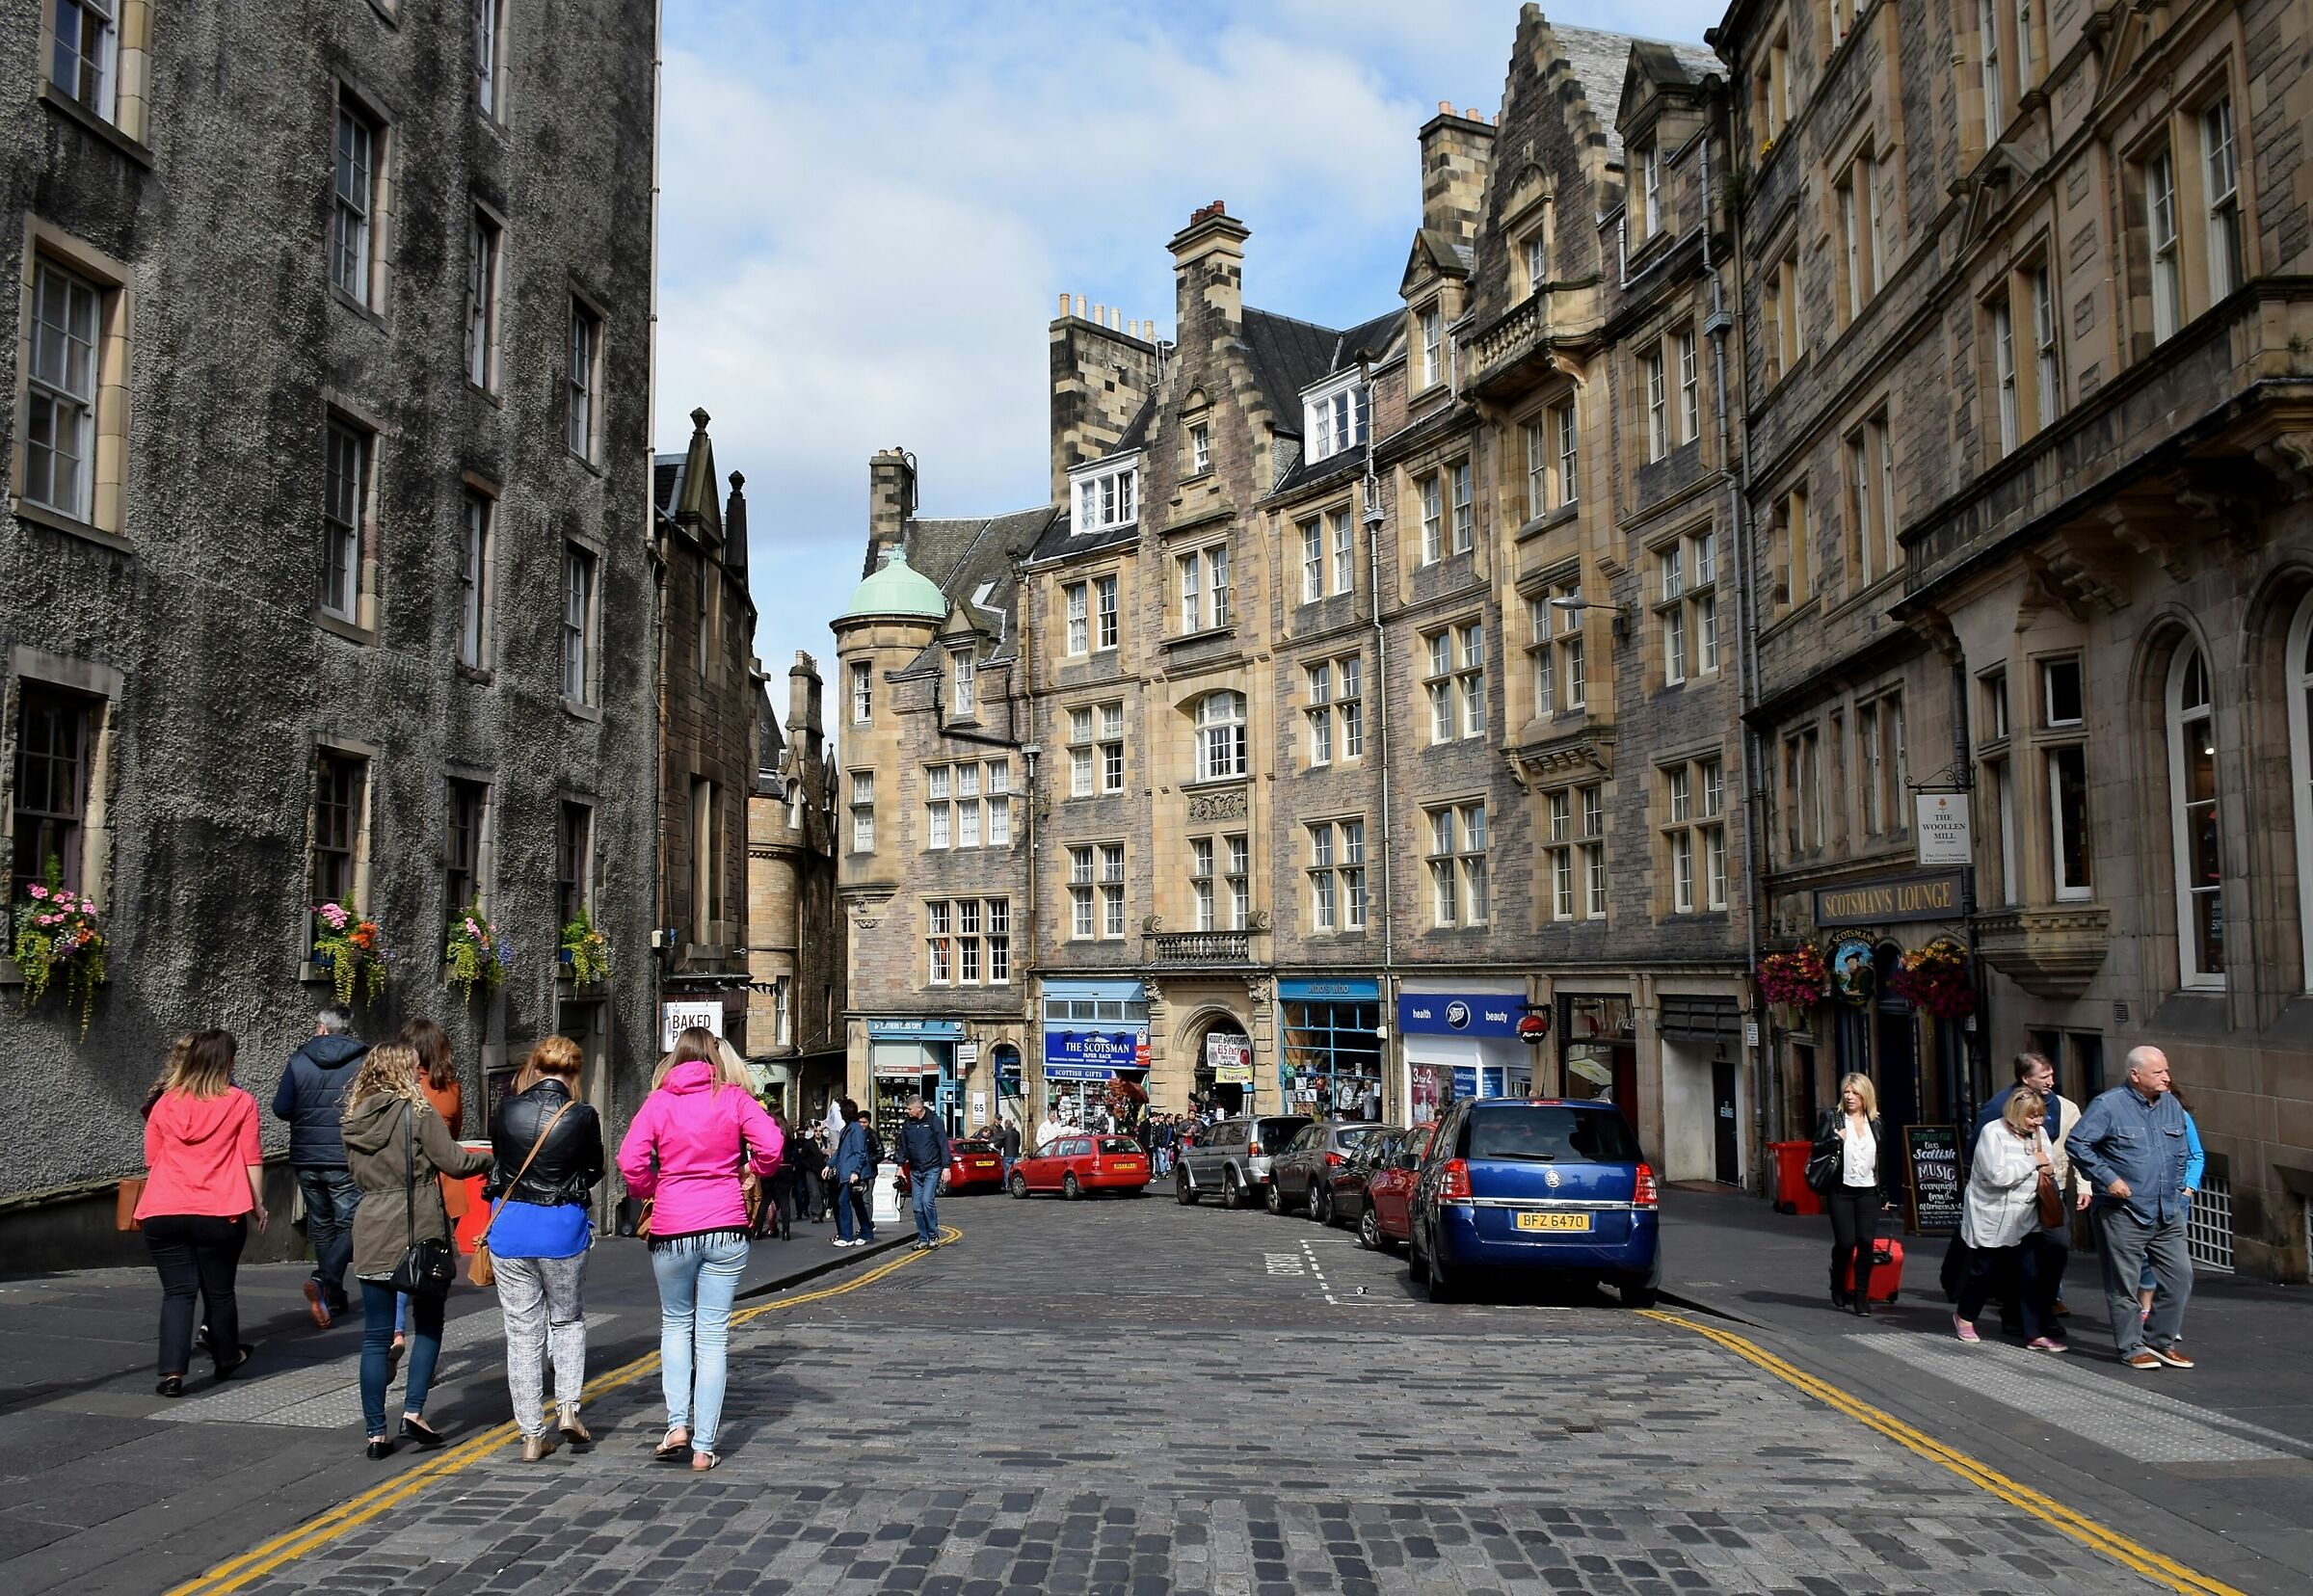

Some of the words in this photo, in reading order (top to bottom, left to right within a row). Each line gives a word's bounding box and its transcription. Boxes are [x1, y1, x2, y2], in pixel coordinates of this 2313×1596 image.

[1825, 889, 1893, 918] SCOTSMAN'S
[1898, 883, 1952, 911] LOUNGE
[1332, 982, 1349, 994] who
[673, 1014, 711, 1029] BAKED
[1413, 1008, 1431, 1019] health
[1485, 1010, 1508, 1023] beauty
[1065, 1042, 1081, 1051] THE
[1084, 1043, 1130, 1053] SCOTSMAN
[1413, 1068, 1419, 1083] 3
[1426, 1069, 1432, 1084] 2
[973, 1104, 984, 1112] 65
[1913, 1148, 1955, 1159] Scottish
[1918, 1164, 1955, 1181] MUSIC
[1524, 1214, 1548, 1227] BFZ
[1551, 1215, 1583, 1228] 6470
